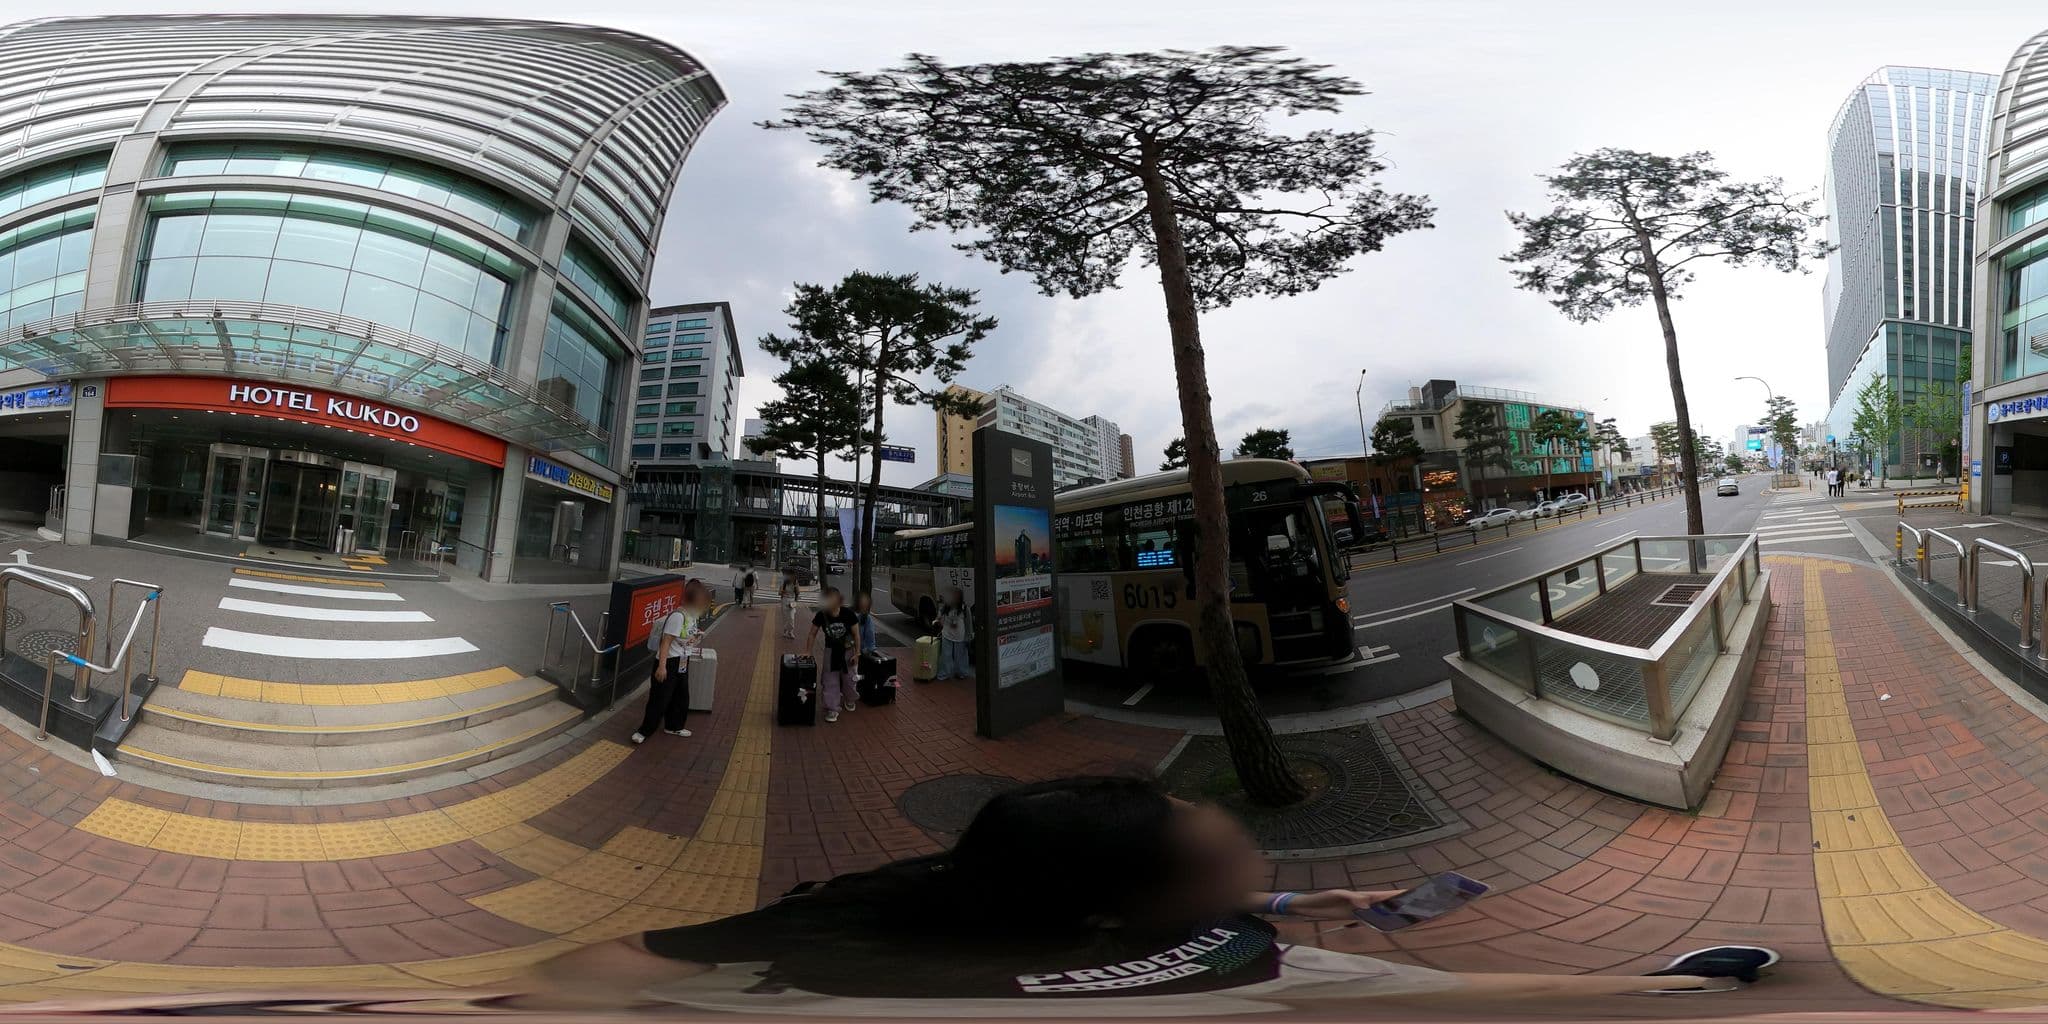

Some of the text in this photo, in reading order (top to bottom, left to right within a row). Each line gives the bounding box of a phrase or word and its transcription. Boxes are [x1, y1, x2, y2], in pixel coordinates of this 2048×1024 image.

[230, 384, 419, 433] HOTEL KUKDO
[1252, 490, 1268, 503] 26
[1124, 502, 1163, 521] 인천공항
[1124, 584, 1176, 608] 6015
[1015, 928, 1239, 985] PRIDEZILLA
